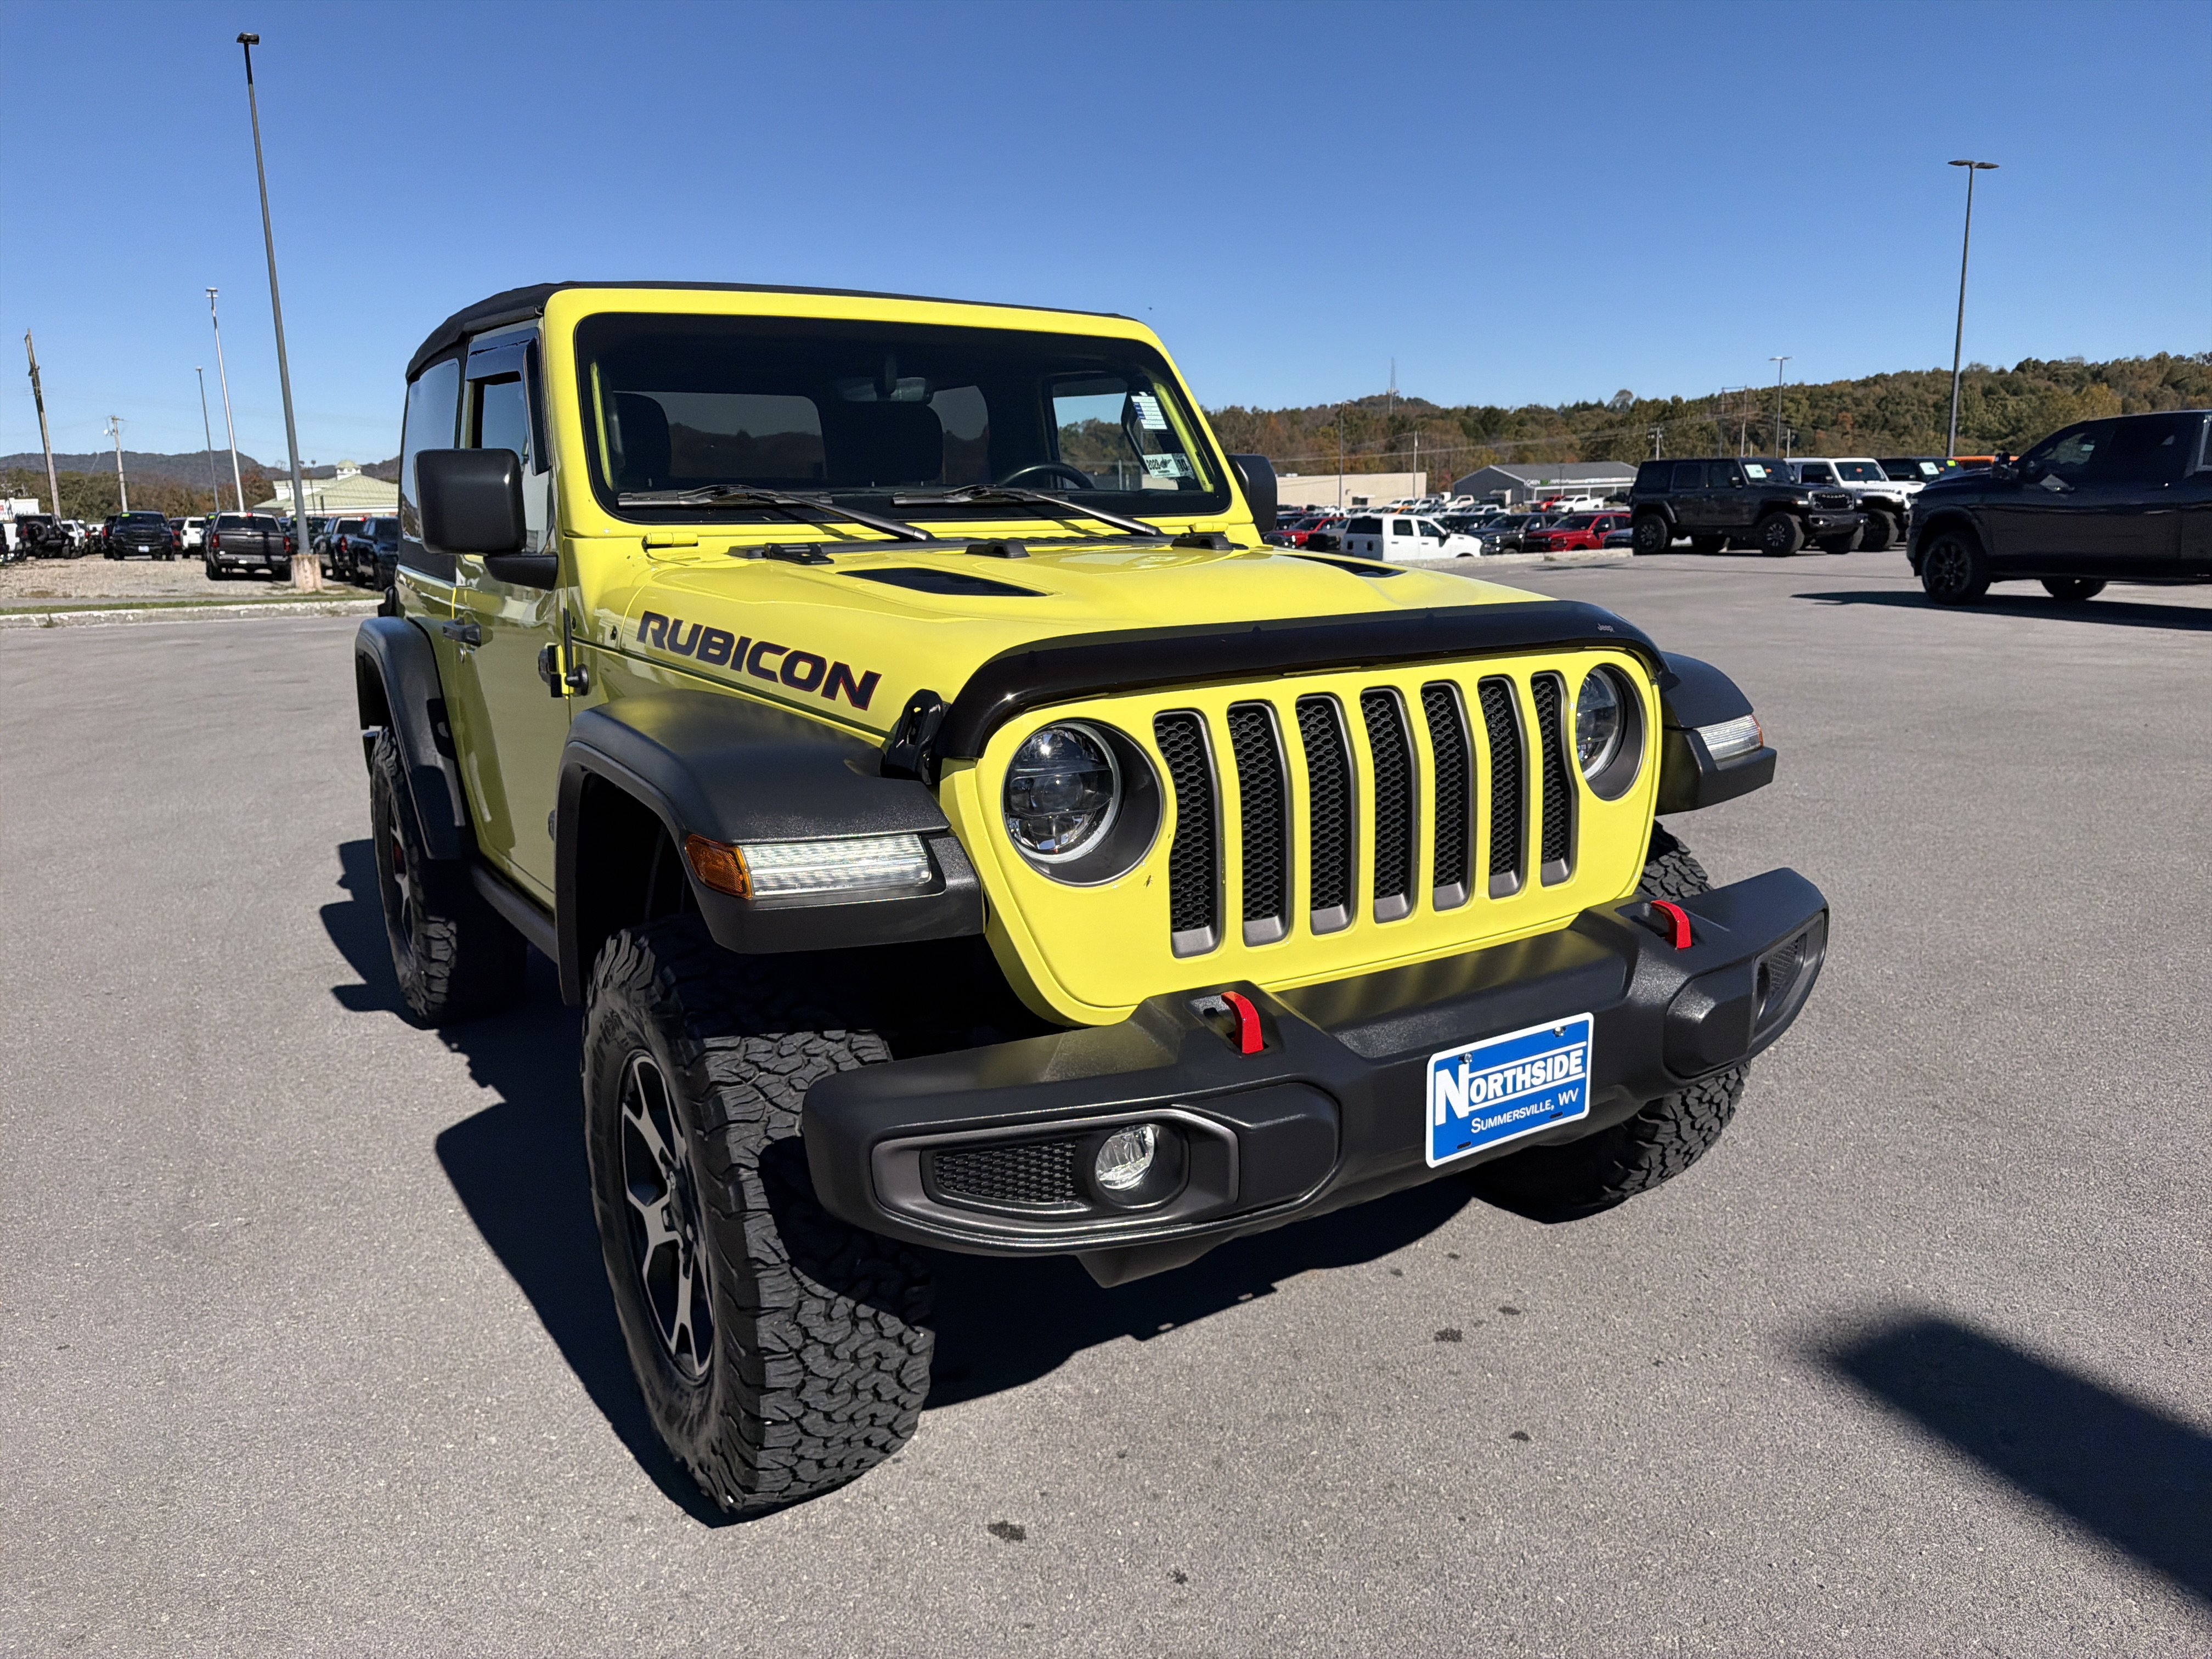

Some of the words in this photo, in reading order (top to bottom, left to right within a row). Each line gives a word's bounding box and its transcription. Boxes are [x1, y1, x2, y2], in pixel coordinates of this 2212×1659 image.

[1597, 623, 1613, 633] Jeep
[636, 610, 882, 711] RUBICON
[1435, 1049, 1584, 1126] NORTHSIDE
[1471, 1099, 1555, 1134] SUMMERSVILLE,
[1558, 1087, 1579, 1106] WV
